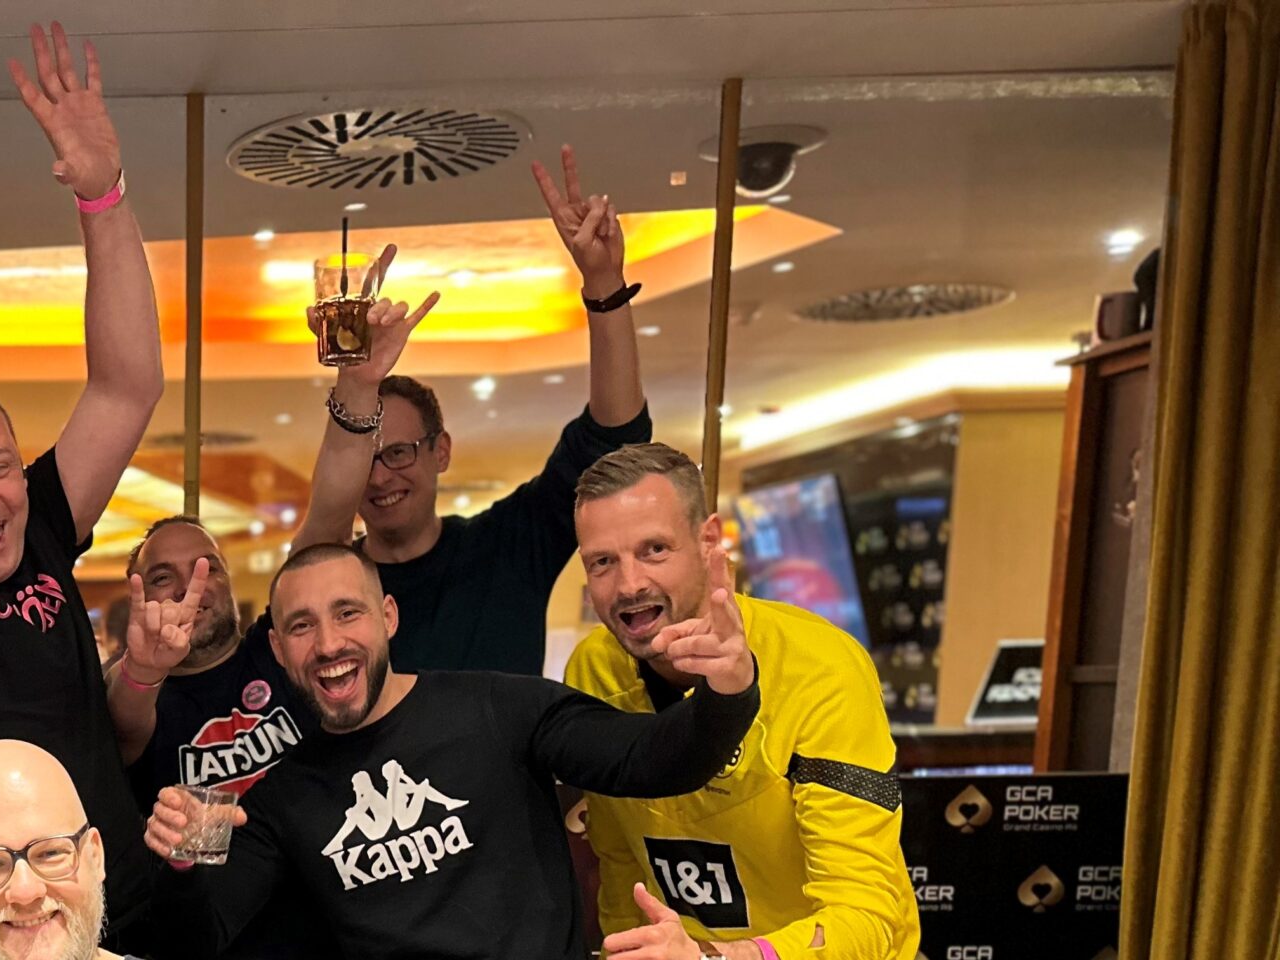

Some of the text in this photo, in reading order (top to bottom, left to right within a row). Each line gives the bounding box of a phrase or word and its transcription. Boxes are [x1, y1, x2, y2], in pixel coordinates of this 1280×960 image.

[1006, 785, 1053, 802] GCA
[1004, 805, 1080, 821] POKER
[329, 815, 474, 891] Kappa
[654, 857, 734, 906] 1&1
[1078, 866, 1123, 881] GCA
[912, 885, 955, 901] KER
[1076, 885, 1121, 901] POK
[947, 946, 993, 960] GCA
